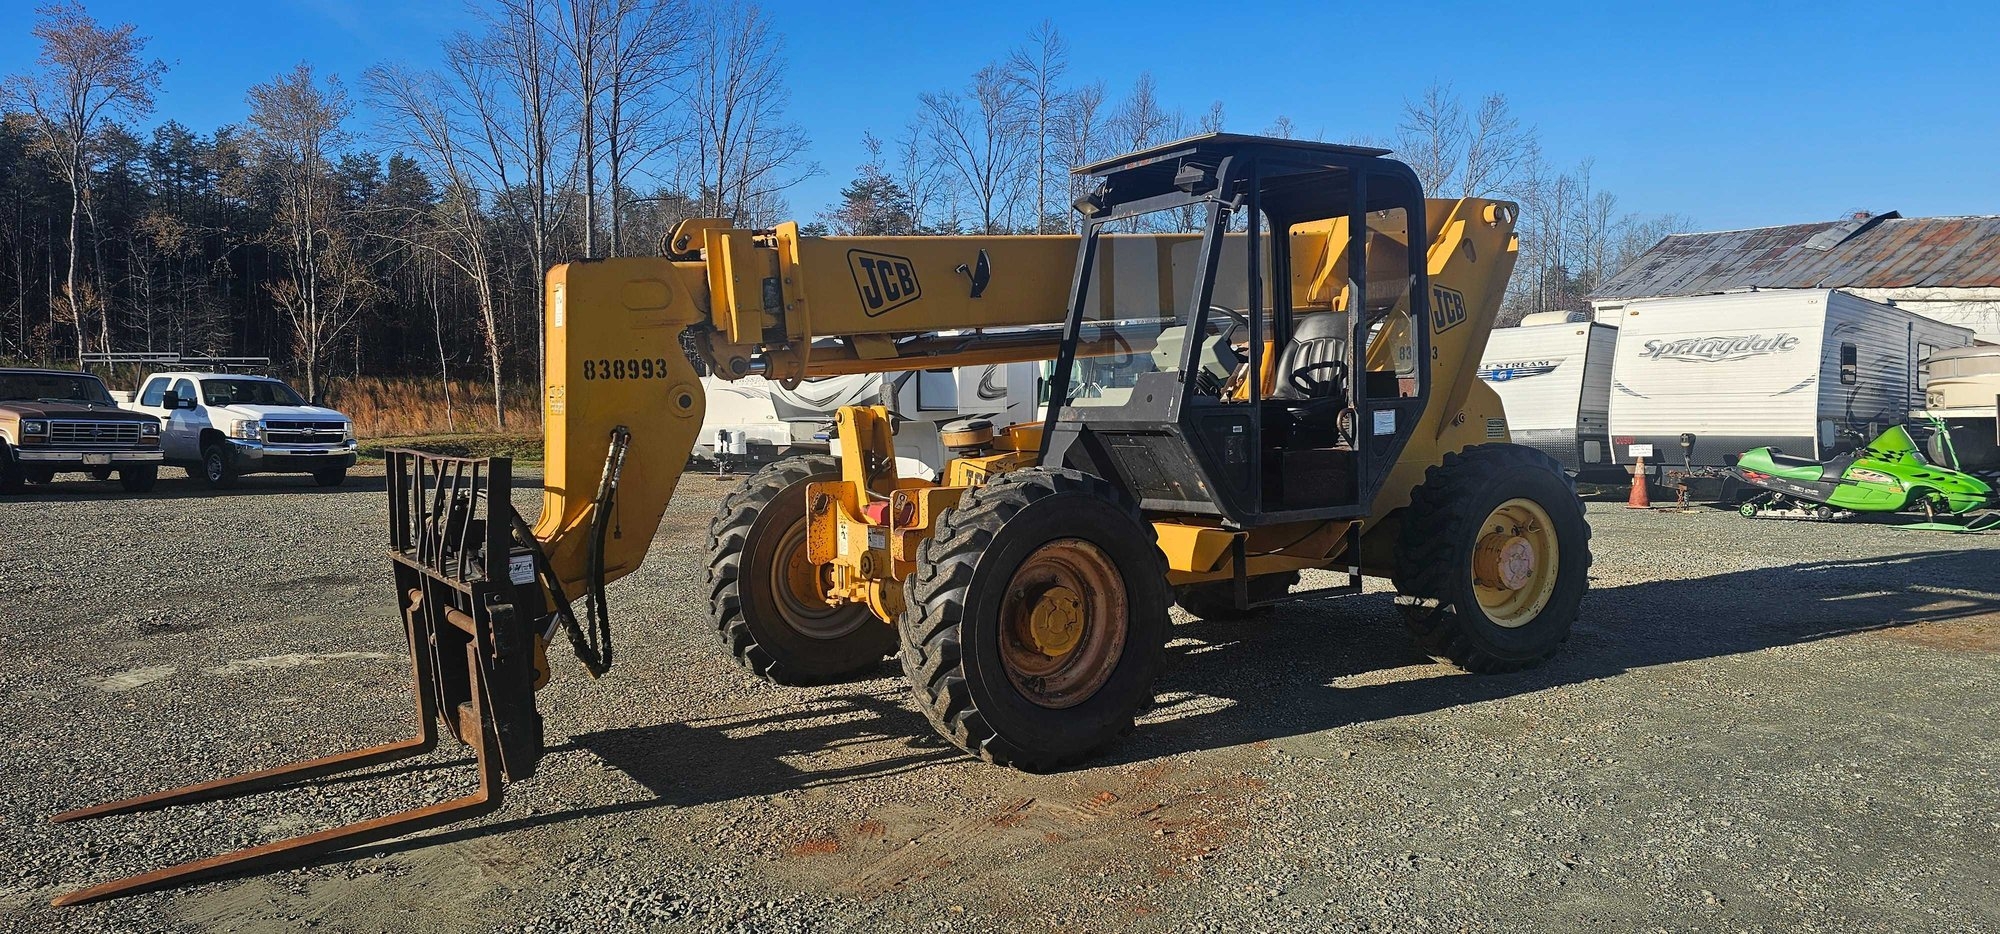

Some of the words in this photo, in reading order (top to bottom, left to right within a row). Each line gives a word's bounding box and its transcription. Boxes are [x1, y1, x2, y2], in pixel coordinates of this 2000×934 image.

[858, 257, 915, 309] JCB
[1433, 288, 1464, 328] JCB
[1639, 333, 1800, 361] Springdale
[584, 358, 668, 380] 838993
[1496, 361, 1549, 369] STREAM
